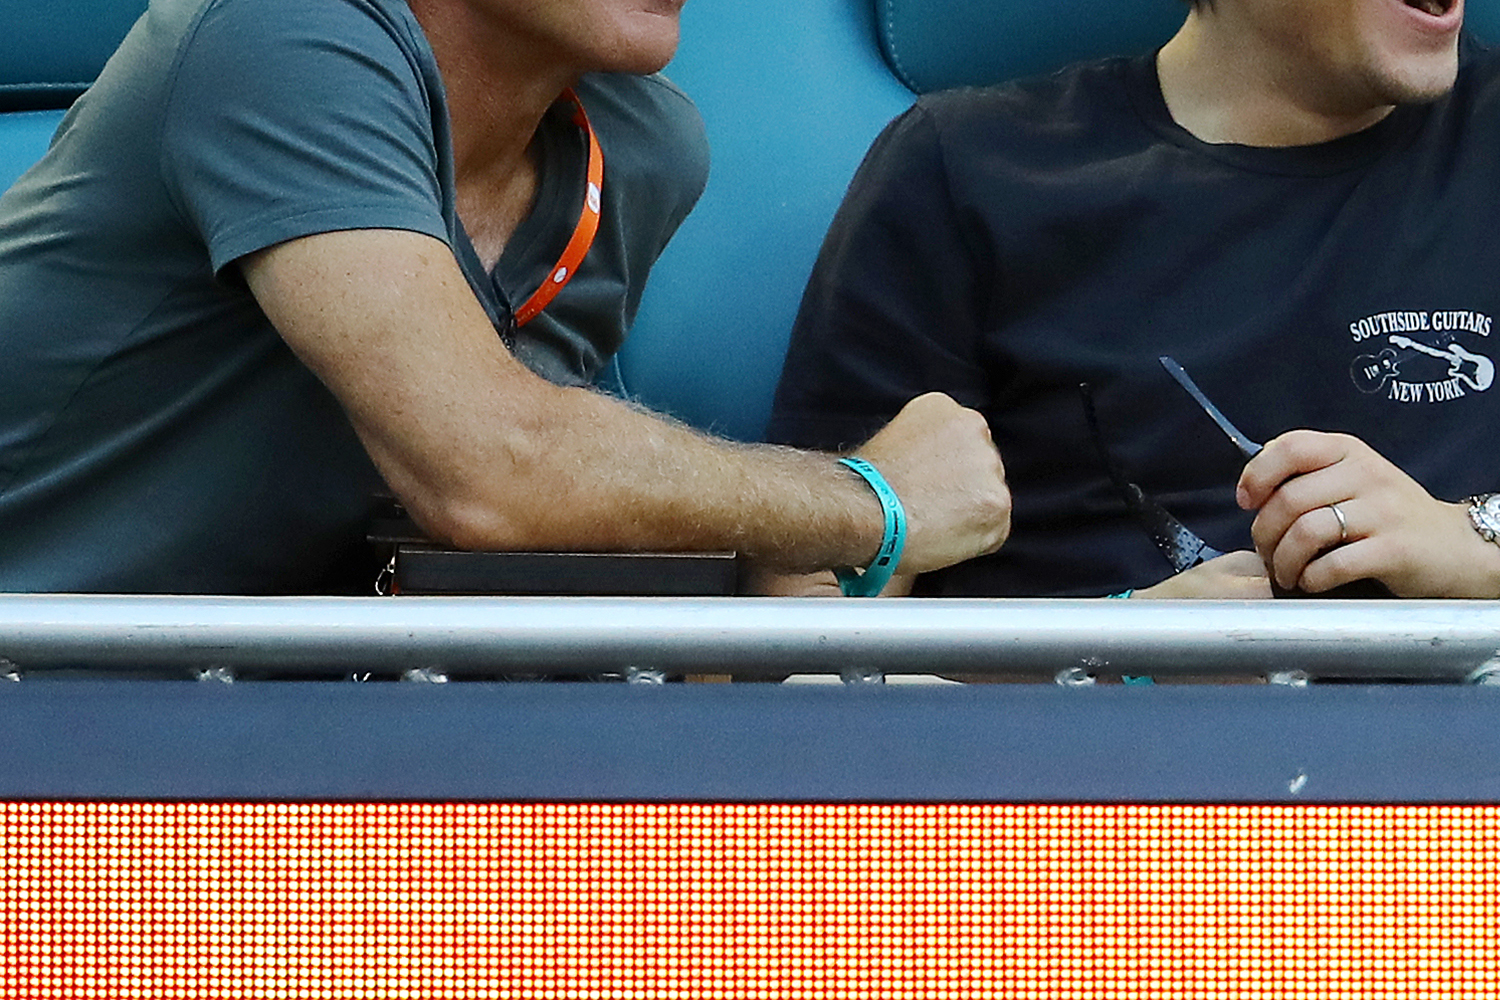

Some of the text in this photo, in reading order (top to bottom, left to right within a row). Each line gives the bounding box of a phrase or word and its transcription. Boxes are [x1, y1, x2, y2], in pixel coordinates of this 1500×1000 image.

[1350, 311, 1492, 342] SOUTHSIDE GUITARS
[1388, 377, 1465, 403] NEW YORK
